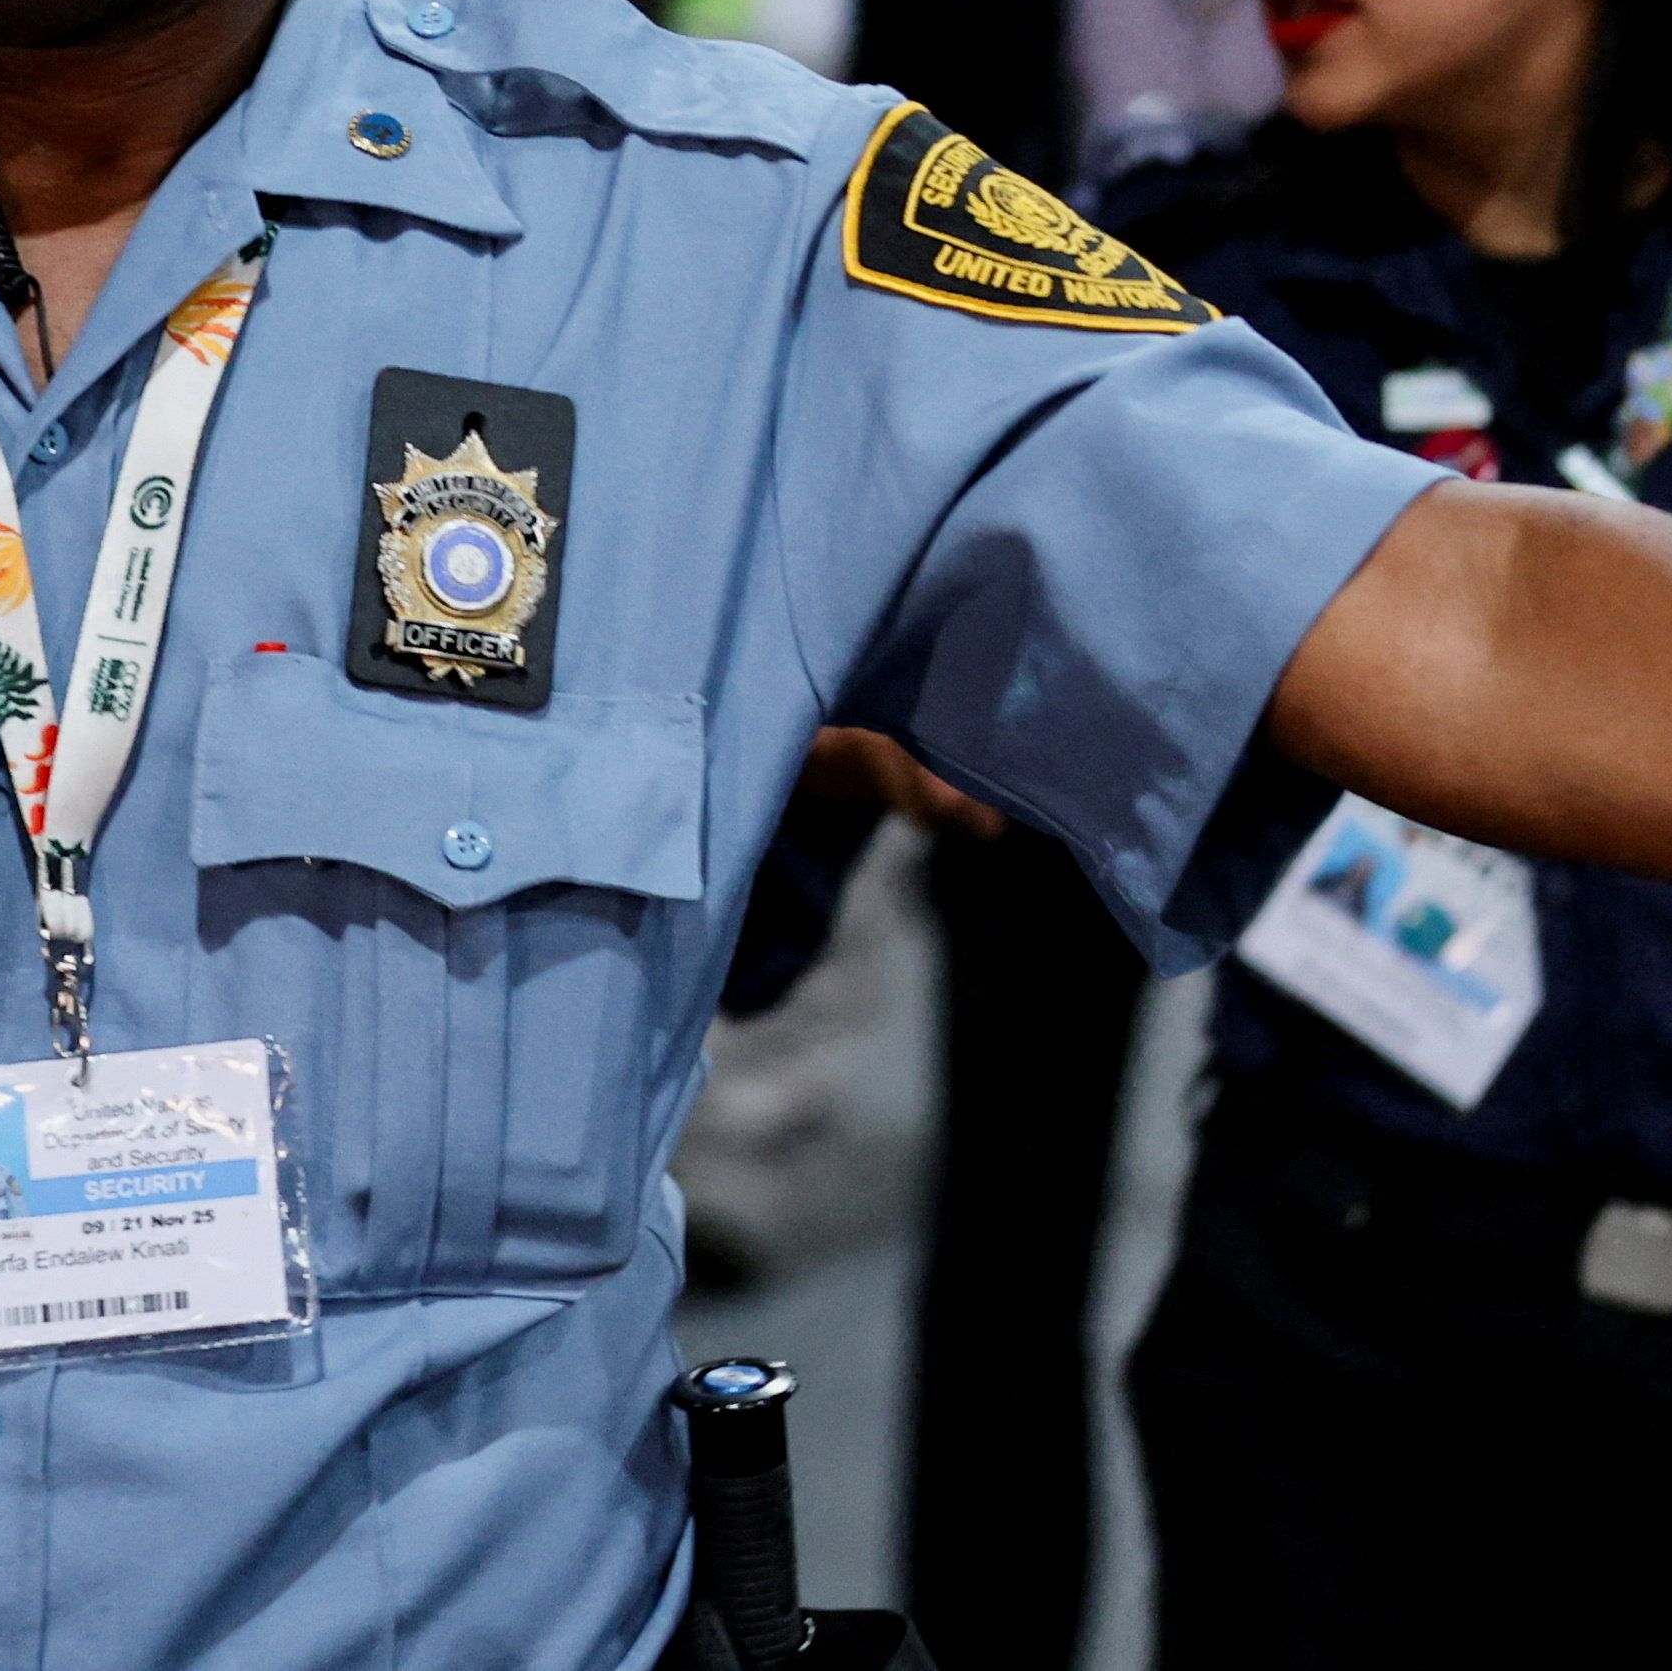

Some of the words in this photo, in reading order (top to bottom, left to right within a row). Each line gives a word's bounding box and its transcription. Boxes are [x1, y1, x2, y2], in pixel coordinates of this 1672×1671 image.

[932, 243, 1054, 299] UNITED
[1062, 277, 1184, 313] NATIONS
[405, 623, 515, 662] OFFICER
[86, 1152, 123, 1172] and
[128, 1145, 207, 1167] Security
[84, 1170, 206, 1202] SECURITY
[121, 1216, 144, 1232] 21
[150, 1213, 187, 1229] Nov
[191, 1209, 217, 1224] 25
[33, 1243, 126, 1270] Endalew
